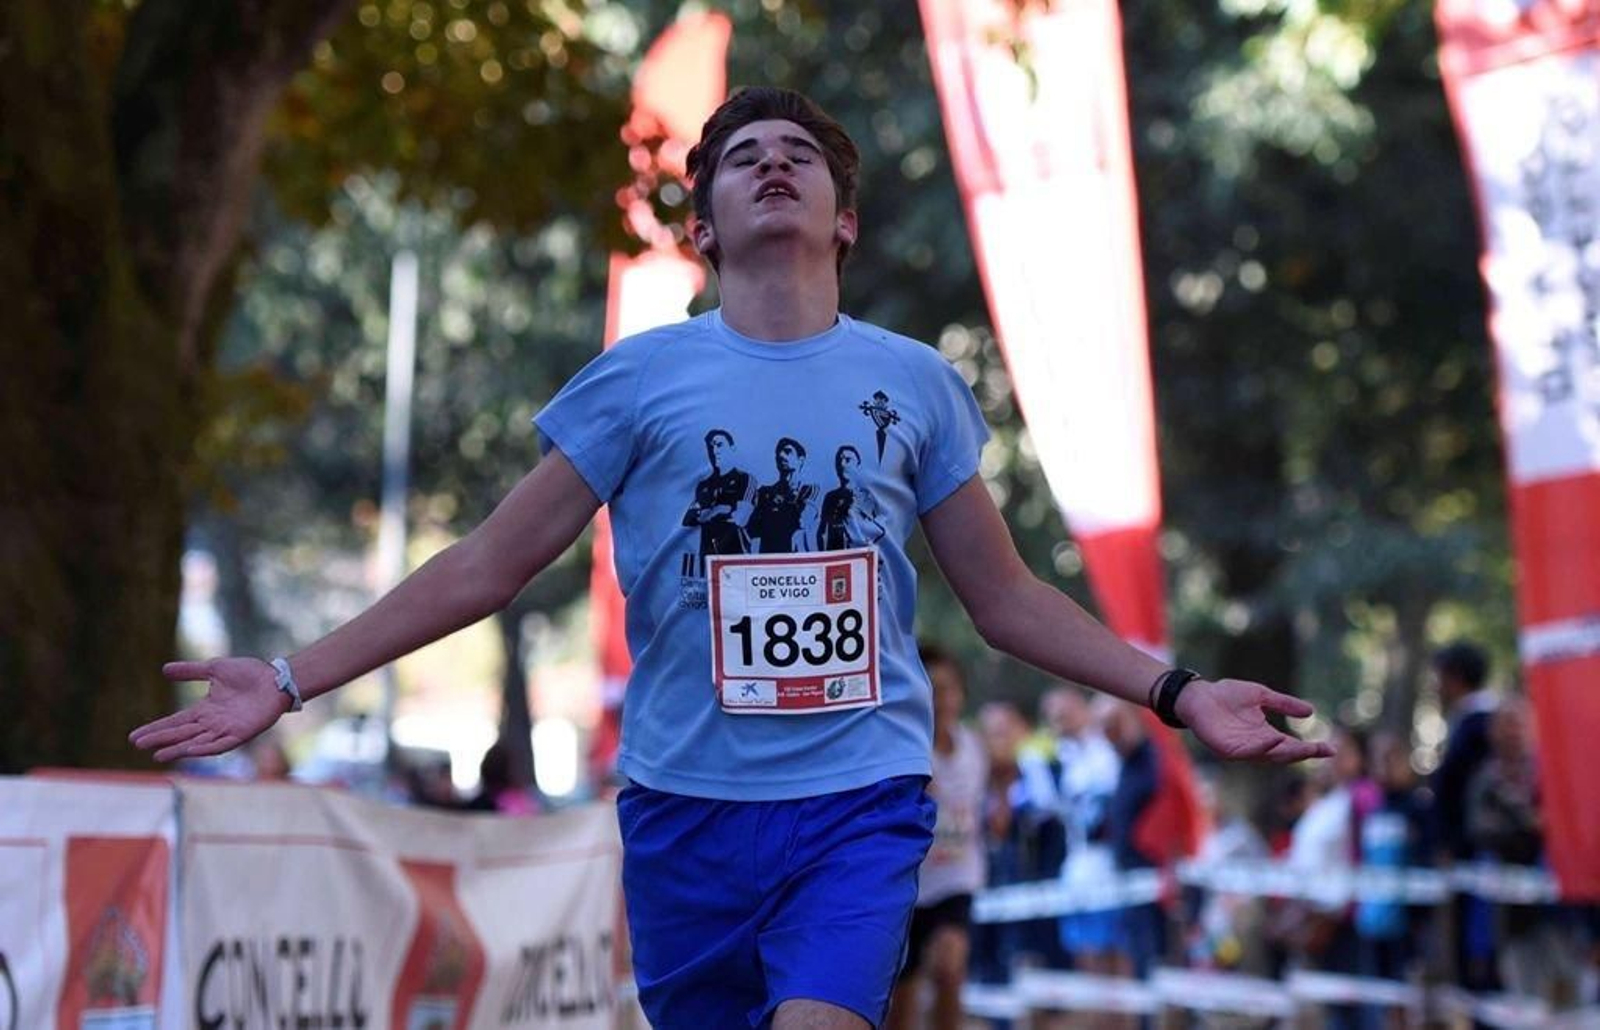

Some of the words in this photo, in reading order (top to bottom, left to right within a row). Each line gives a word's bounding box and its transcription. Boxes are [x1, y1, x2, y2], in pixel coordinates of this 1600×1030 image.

[751, 574, 817, 587] CONCELLO
[760, 588, 776, 599] DE
[780, 587, 810, 598] VIGO
[729, 608, 865, 668] 1838
